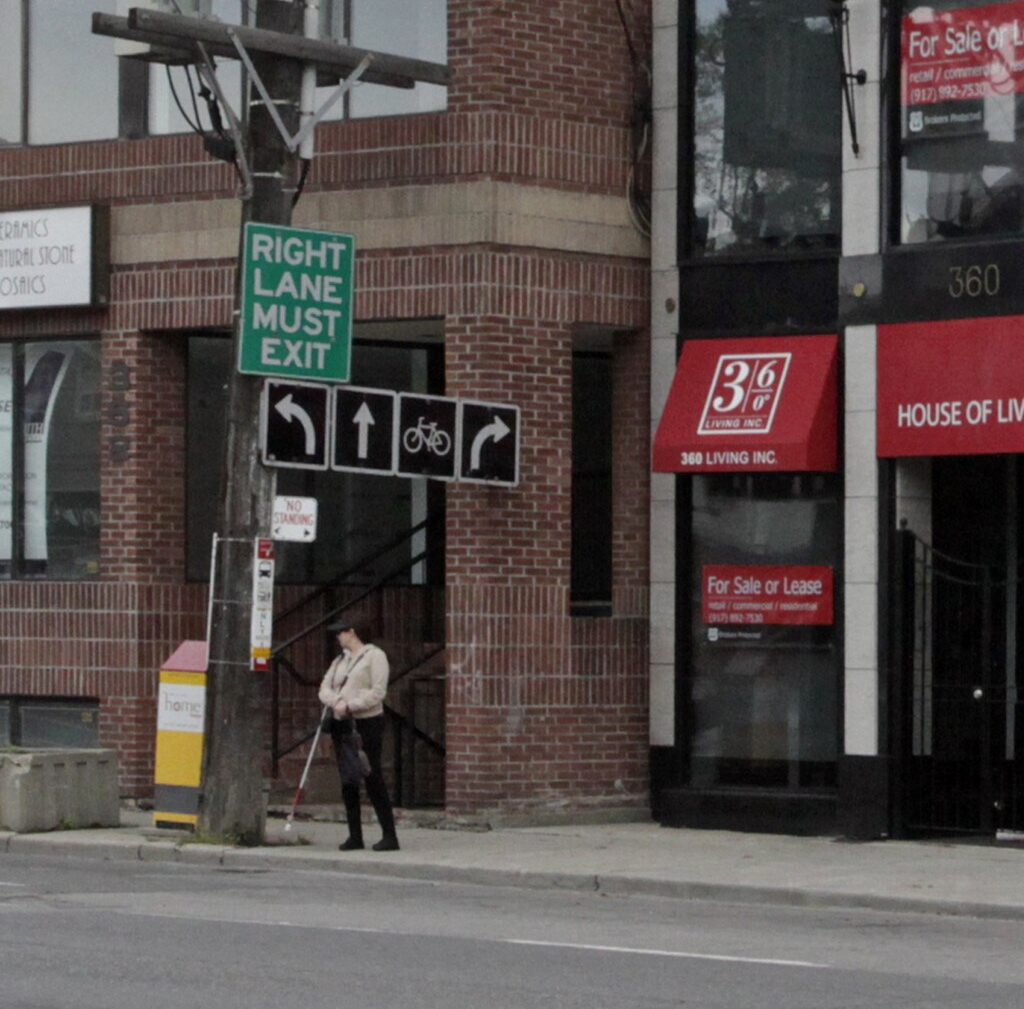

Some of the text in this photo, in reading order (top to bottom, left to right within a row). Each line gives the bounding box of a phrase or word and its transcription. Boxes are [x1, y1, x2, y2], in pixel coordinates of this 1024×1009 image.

[909, 30, 940, 58] For
[944, 23, 982, 55] Sale
[987, 26, 1009, 50] or
[909, 68, 935, 83] retail
[910, 88, 938, 103] (917)
[38, 244, 75, 266] STONE
[251, 233, 346, 271] RIGHT
[0, 274, 46, 297] OSAICS
[253, 267, 343, 305] LANE
[947, 263, 1000, 299] 360
[252, 302, 342, 337] MUST
[261, 336, 332, 370] EXIT
[705, 418, 740, 429] LIVING
[897, 401, 962, 428] HOUSE
[965, 399, 993, 425] OF
[680, 451, 703, 466] 360
[706, 451, 749, 465] LIVING
[286, 499, 303, 513] NO
[273, 512, 314, 527] STANDING
[707, 575, 823, 596] For Sale or Lease
[163, 691, 201, 713] home
